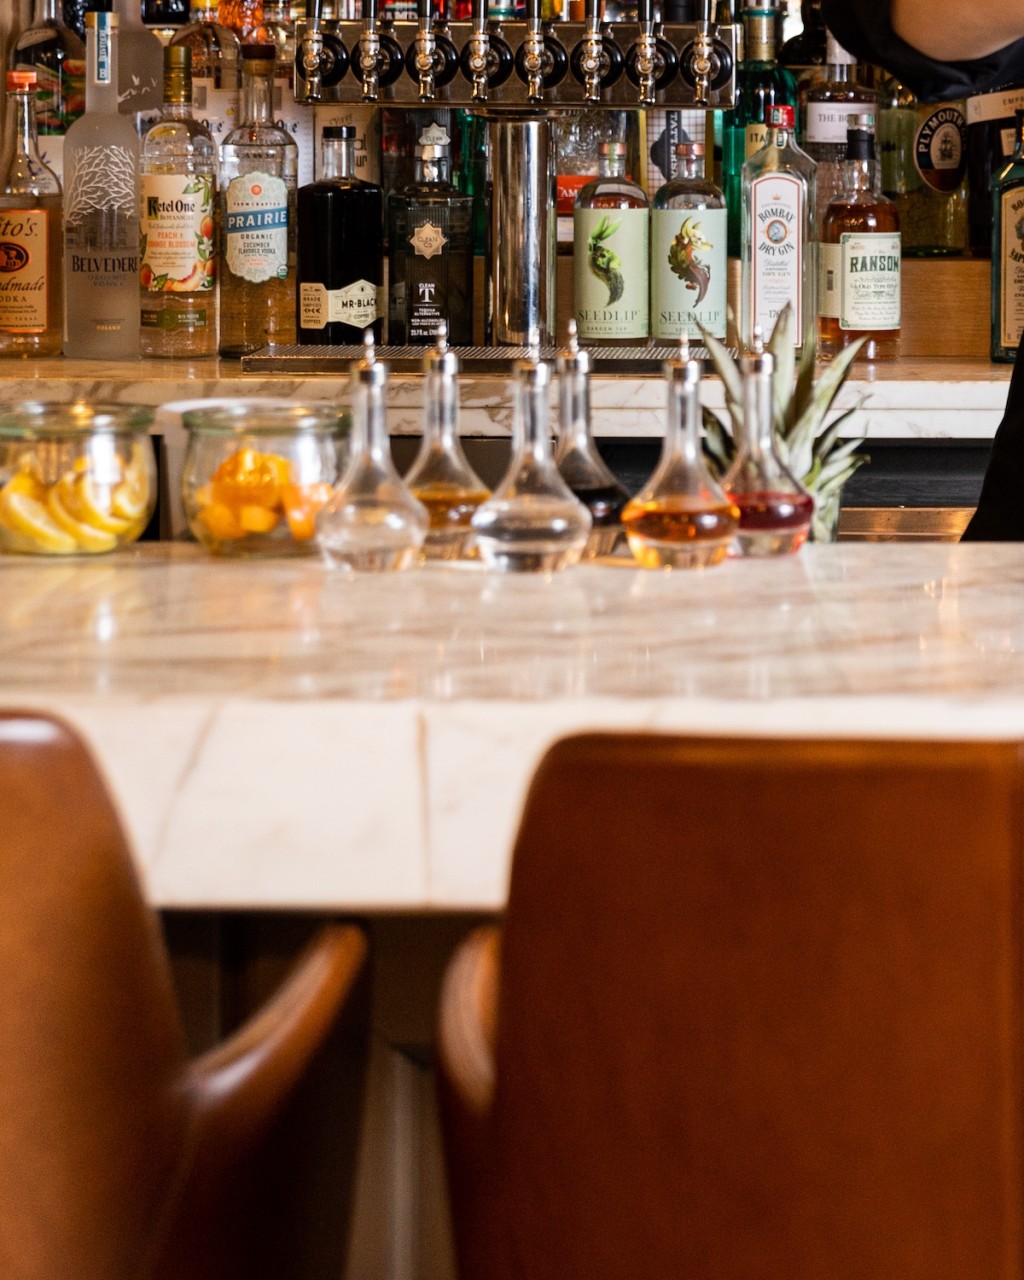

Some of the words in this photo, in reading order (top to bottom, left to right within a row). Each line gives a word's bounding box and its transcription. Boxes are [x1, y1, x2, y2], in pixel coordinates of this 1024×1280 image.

[818, 114, 834, 122] THE
[750, 133, 765, 143] ITA
[918, 109, 964, 153] PLYMOUTH
[670, 111, 679, 180] TATTERSA
[147, 197, 173, 216] Ketel
[175, 200, 195, 213] One
[228, 210, 287, 229] PRAIRIE
[758, 207, 796, 223] BOMBAY
[157, 231, 178, 240] PEACH
[759, 241, 777, 256] DRY
[777, 241, 795, 256] GIN
[72, 254, 138, 273] BELVEDERE
[419, 288, 435, 302] T
[577, 310, 637, 321] SEEDLIP
[660, 310, 720, 322] SEEDLIP
